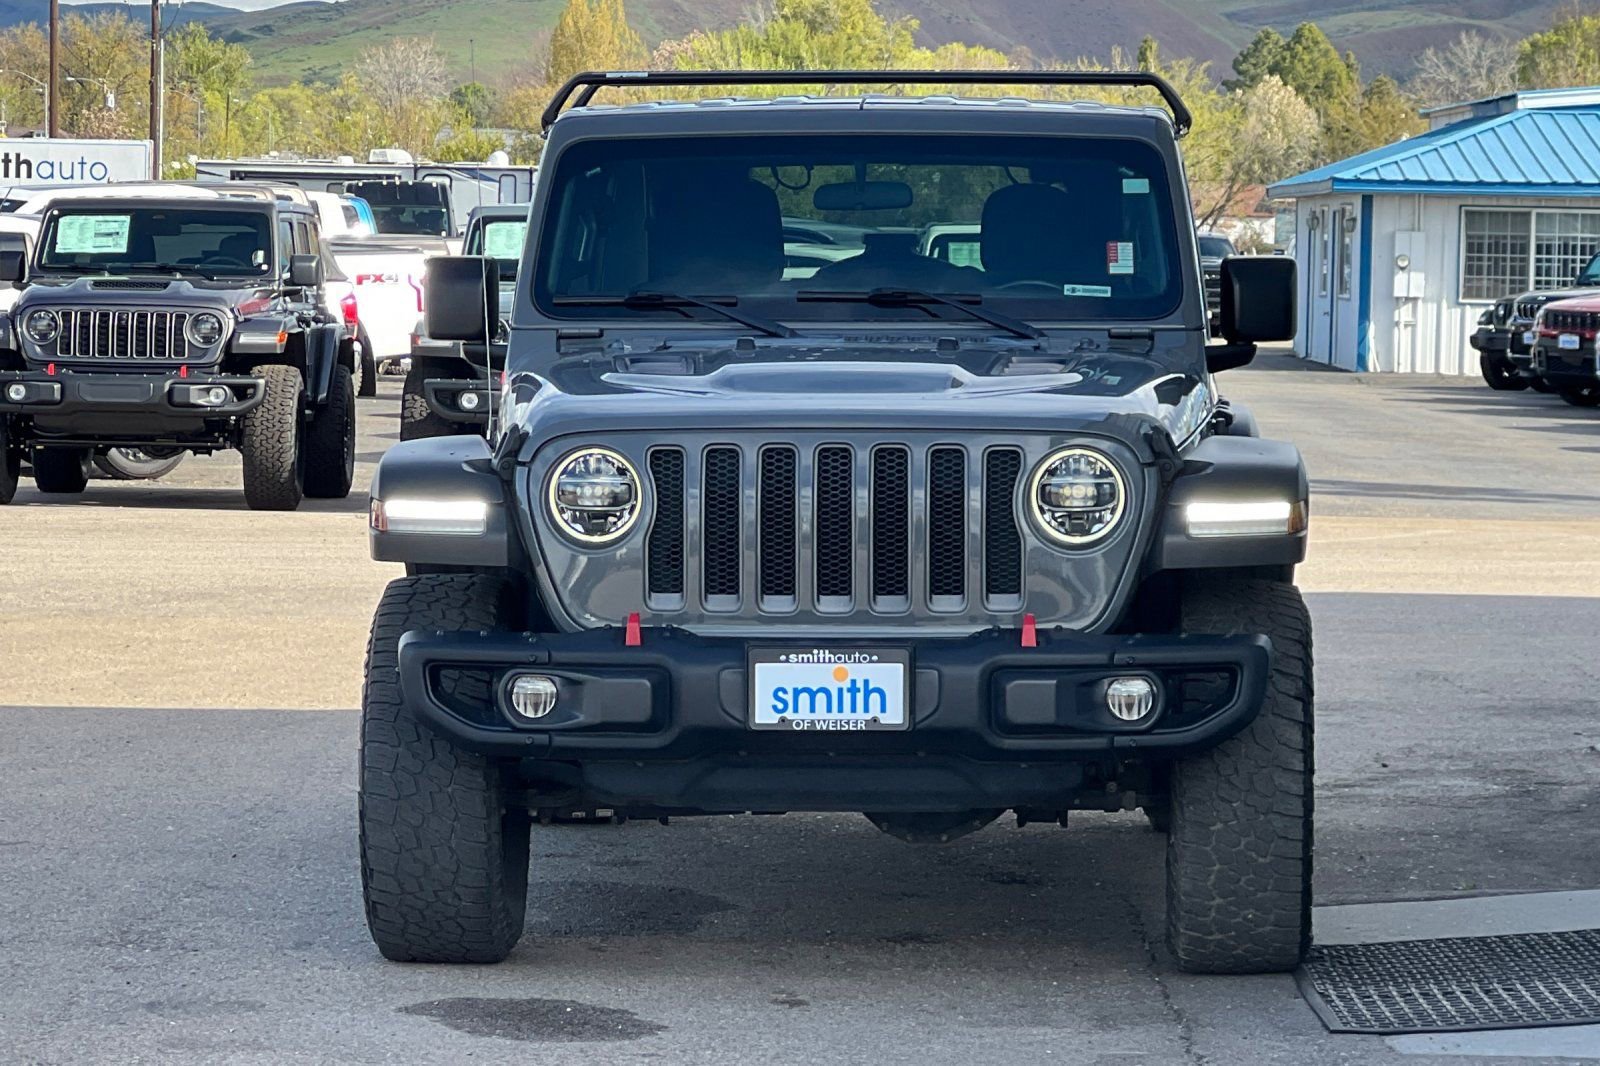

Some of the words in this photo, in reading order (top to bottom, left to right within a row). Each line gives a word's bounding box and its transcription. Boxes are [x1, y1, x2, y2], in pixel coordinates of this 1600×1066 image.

[356, 273, 399, 285] FX4
[788, 649, 870, 663] smithauto
[771, 666, 887, 715] smith
[792, 719, 811, 731] OF
[815, 719, 866, 731] WEISER
